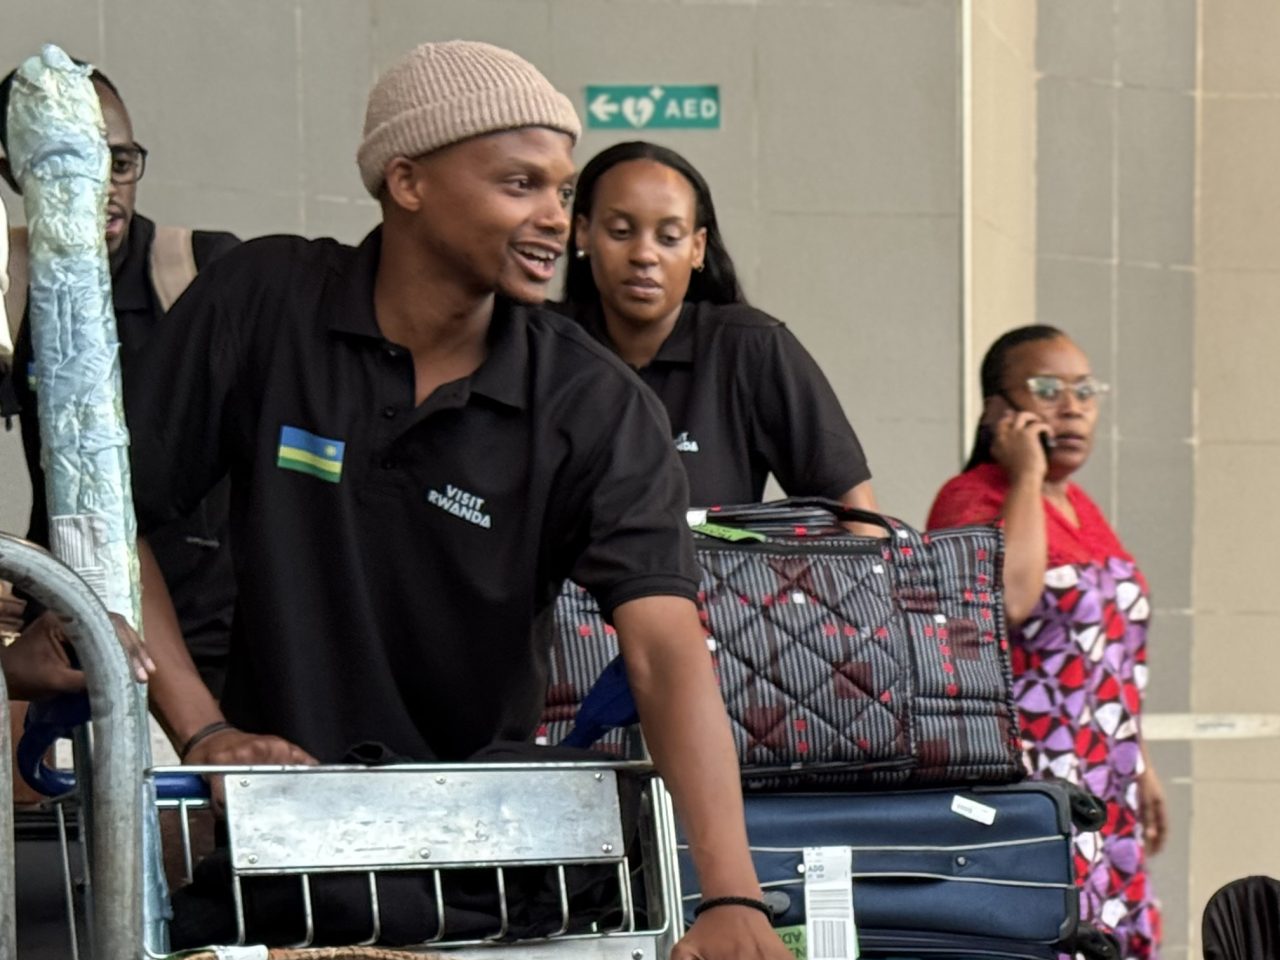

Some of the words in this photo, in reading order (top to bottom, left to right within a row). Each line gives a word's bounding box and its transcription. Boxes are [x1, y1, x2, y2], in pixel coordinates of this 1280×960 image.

[665, 98, 717, 119] AED
[428, 490, 491, 528] RWANDA
[446, 484, 485, 511] VISIT
